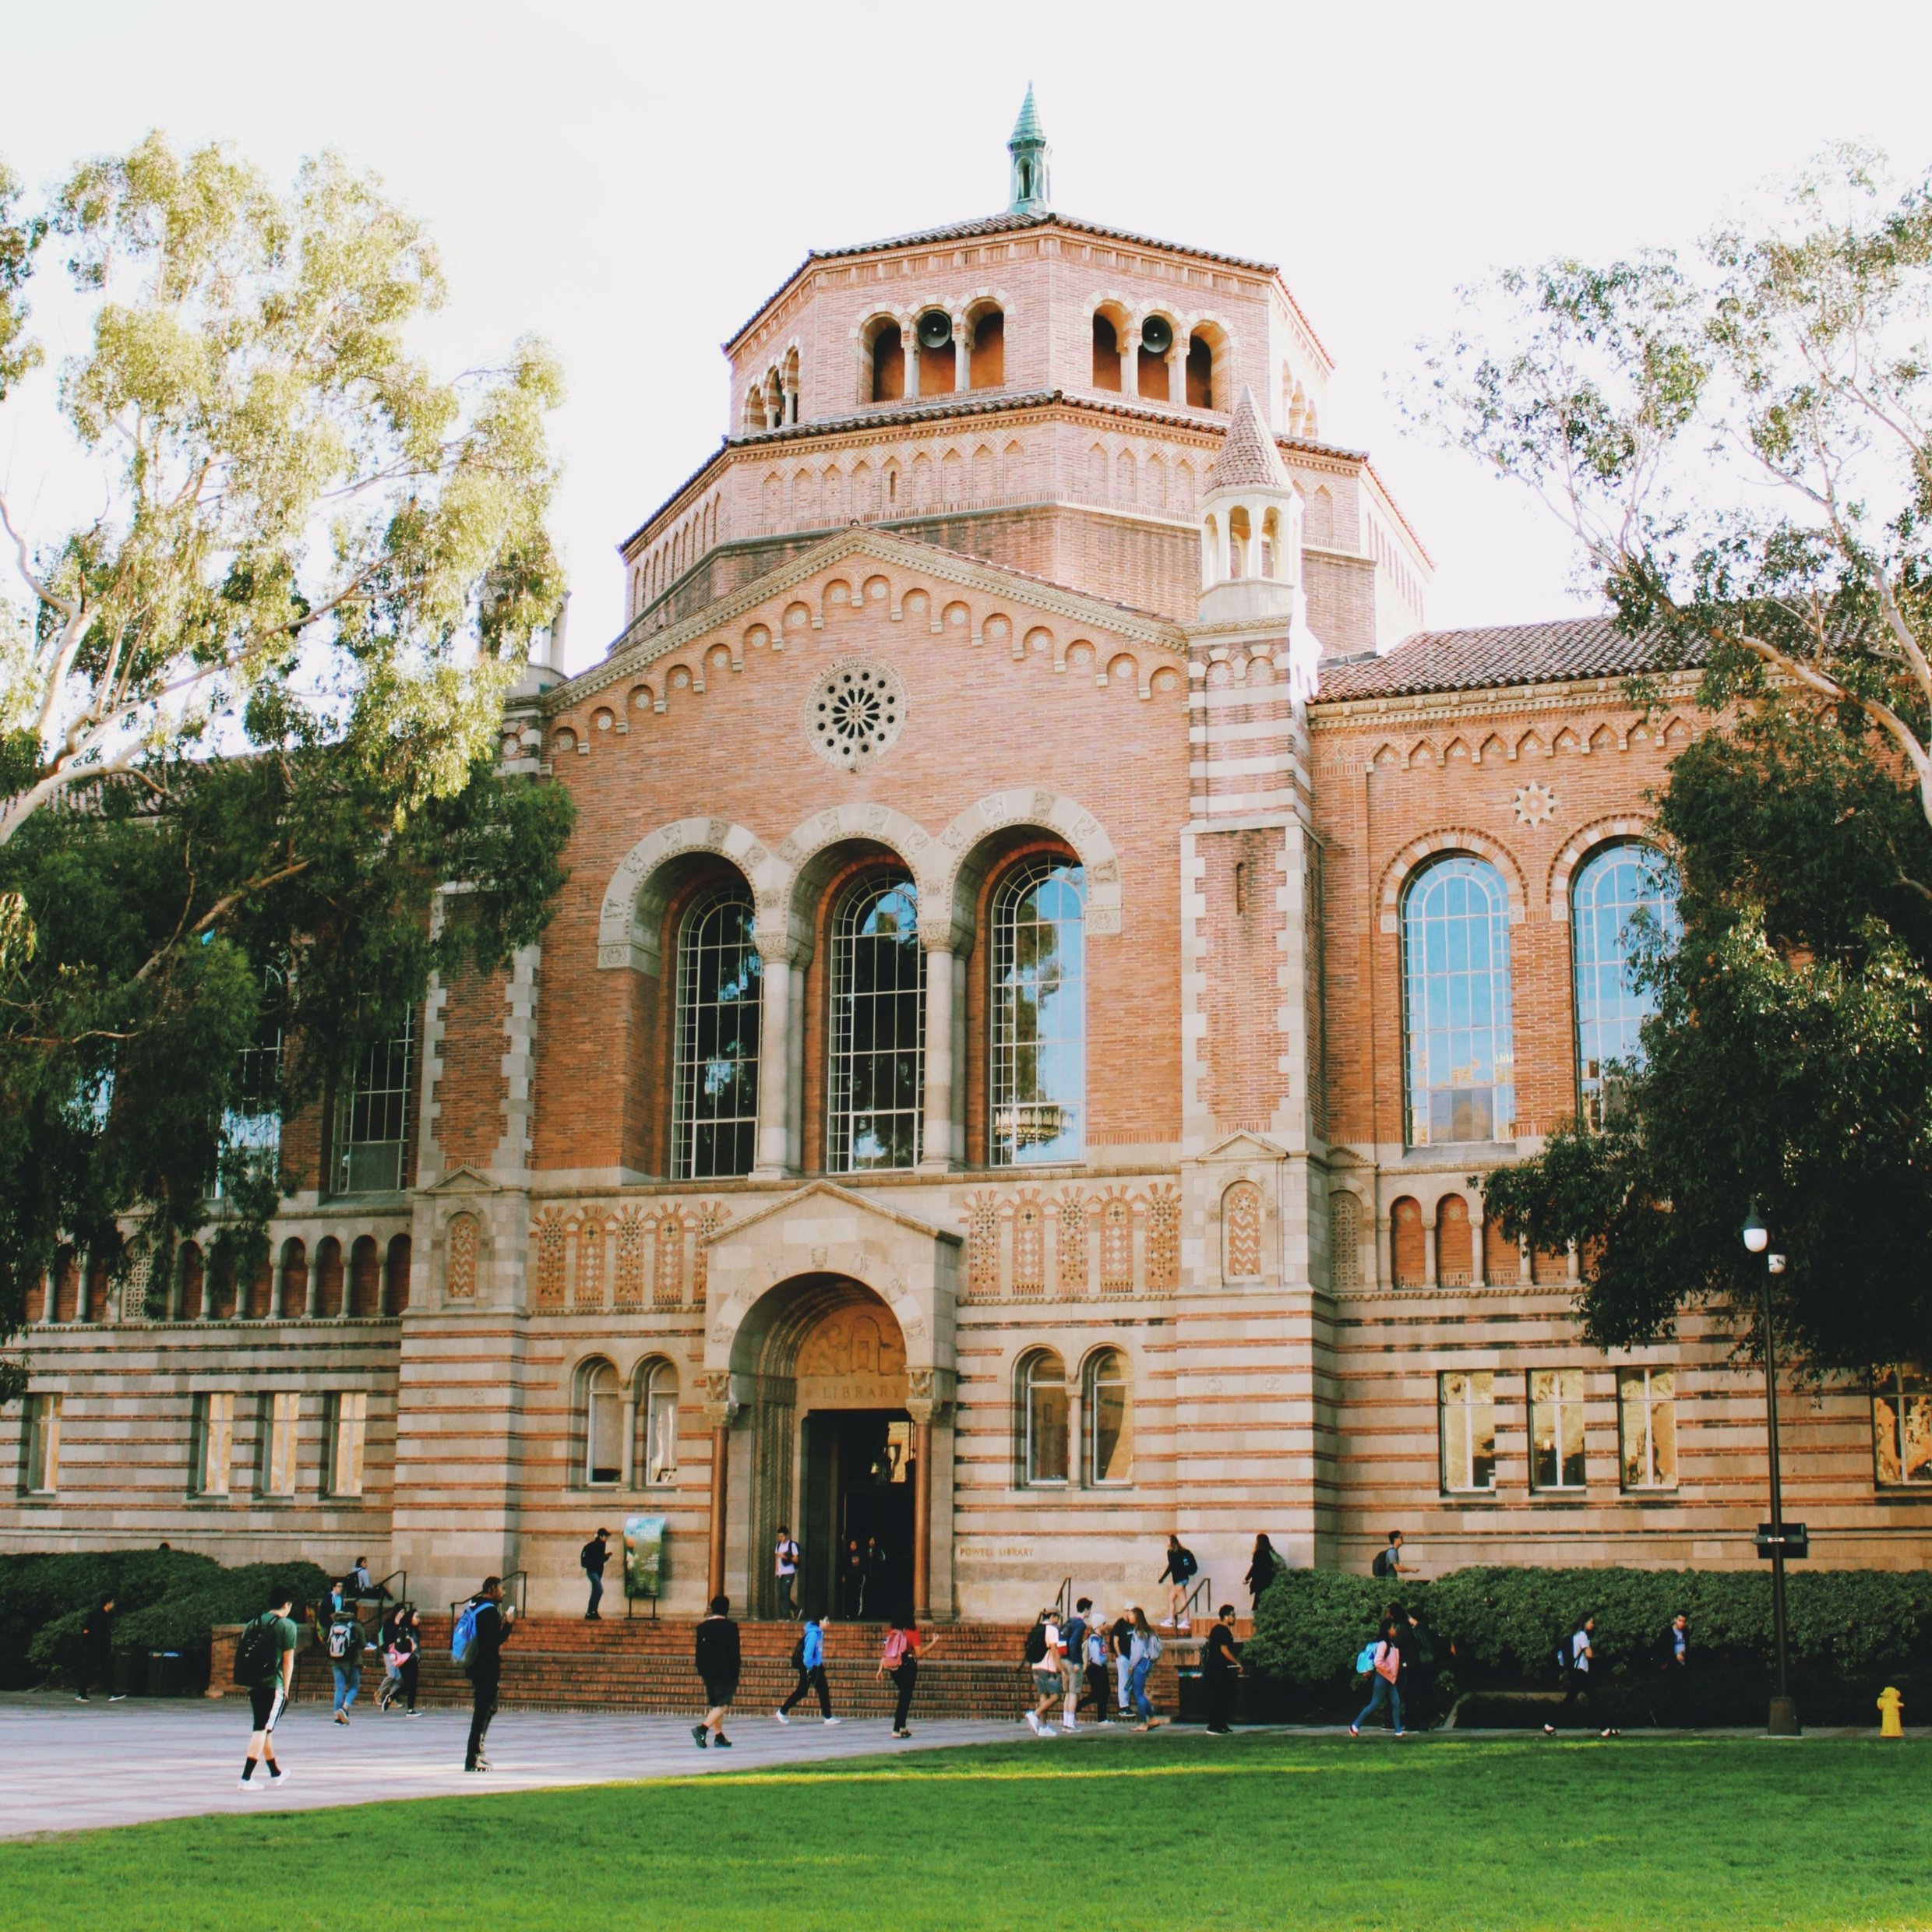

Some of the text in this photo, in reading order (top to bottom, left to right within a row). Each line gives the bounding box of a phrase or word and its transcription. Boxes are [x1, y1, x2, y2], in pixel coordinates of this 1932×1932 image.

[823, 1386, 902, 1399] LIBRARY
[960, 1546, 1034, 1557] POWELL LIBRARY
